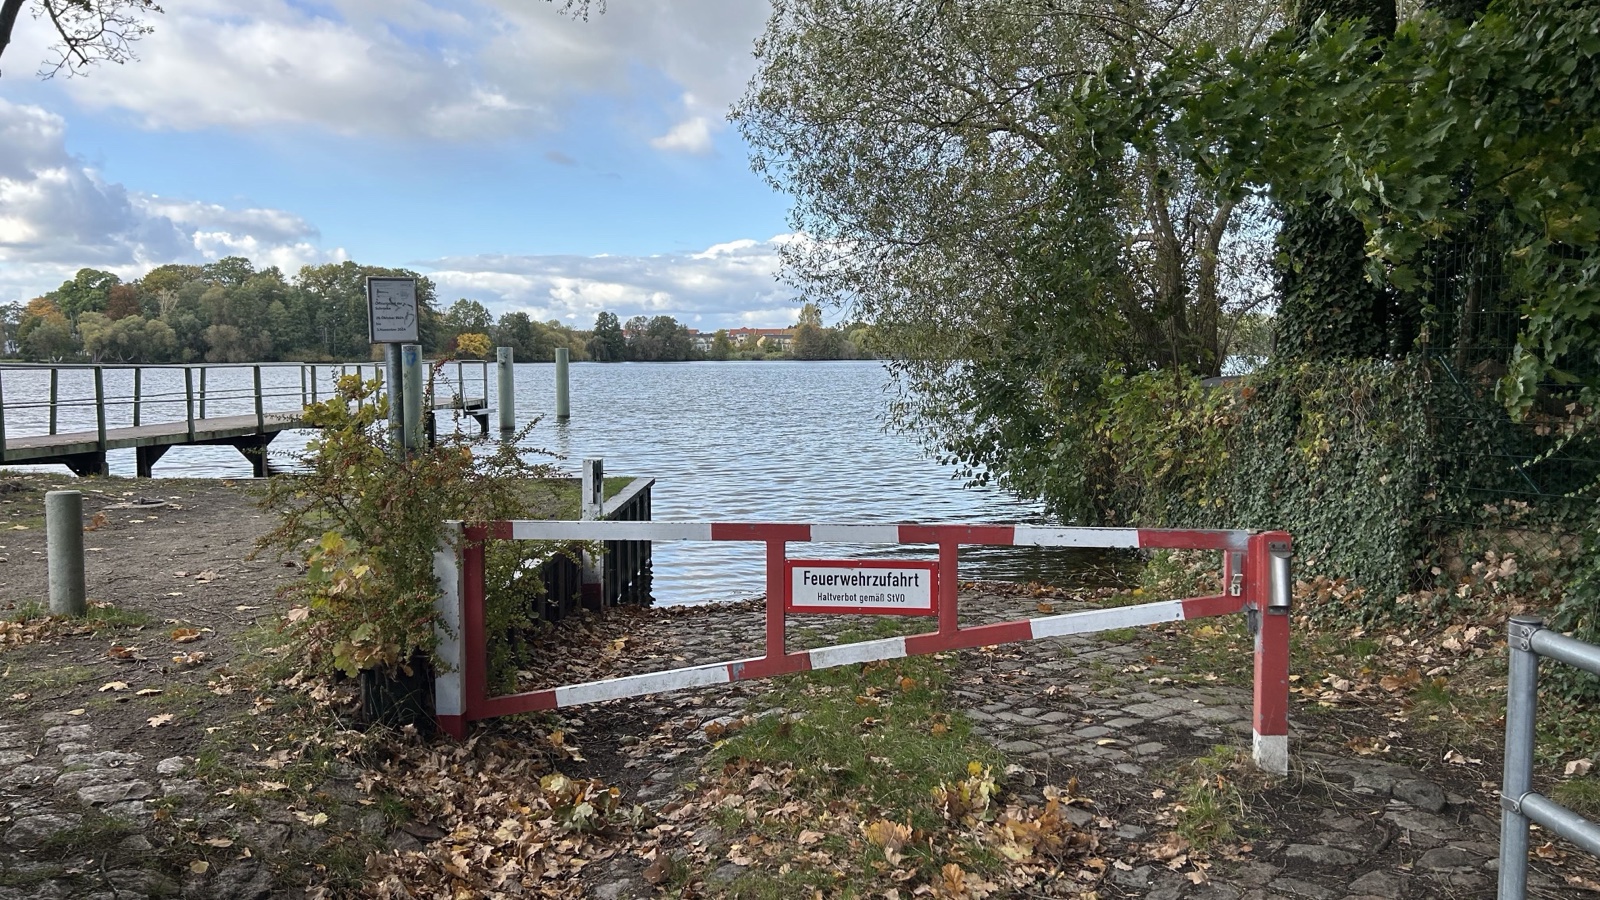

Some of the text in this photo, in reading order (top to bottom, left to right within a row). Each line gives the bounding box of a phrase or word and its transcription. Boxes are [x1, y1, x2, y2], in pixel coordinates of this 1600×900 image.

[803, 570, 919, 587] Feuerwehrzufahrt
[817, 592, 905, 604] Haltverbot gemäß StVO
